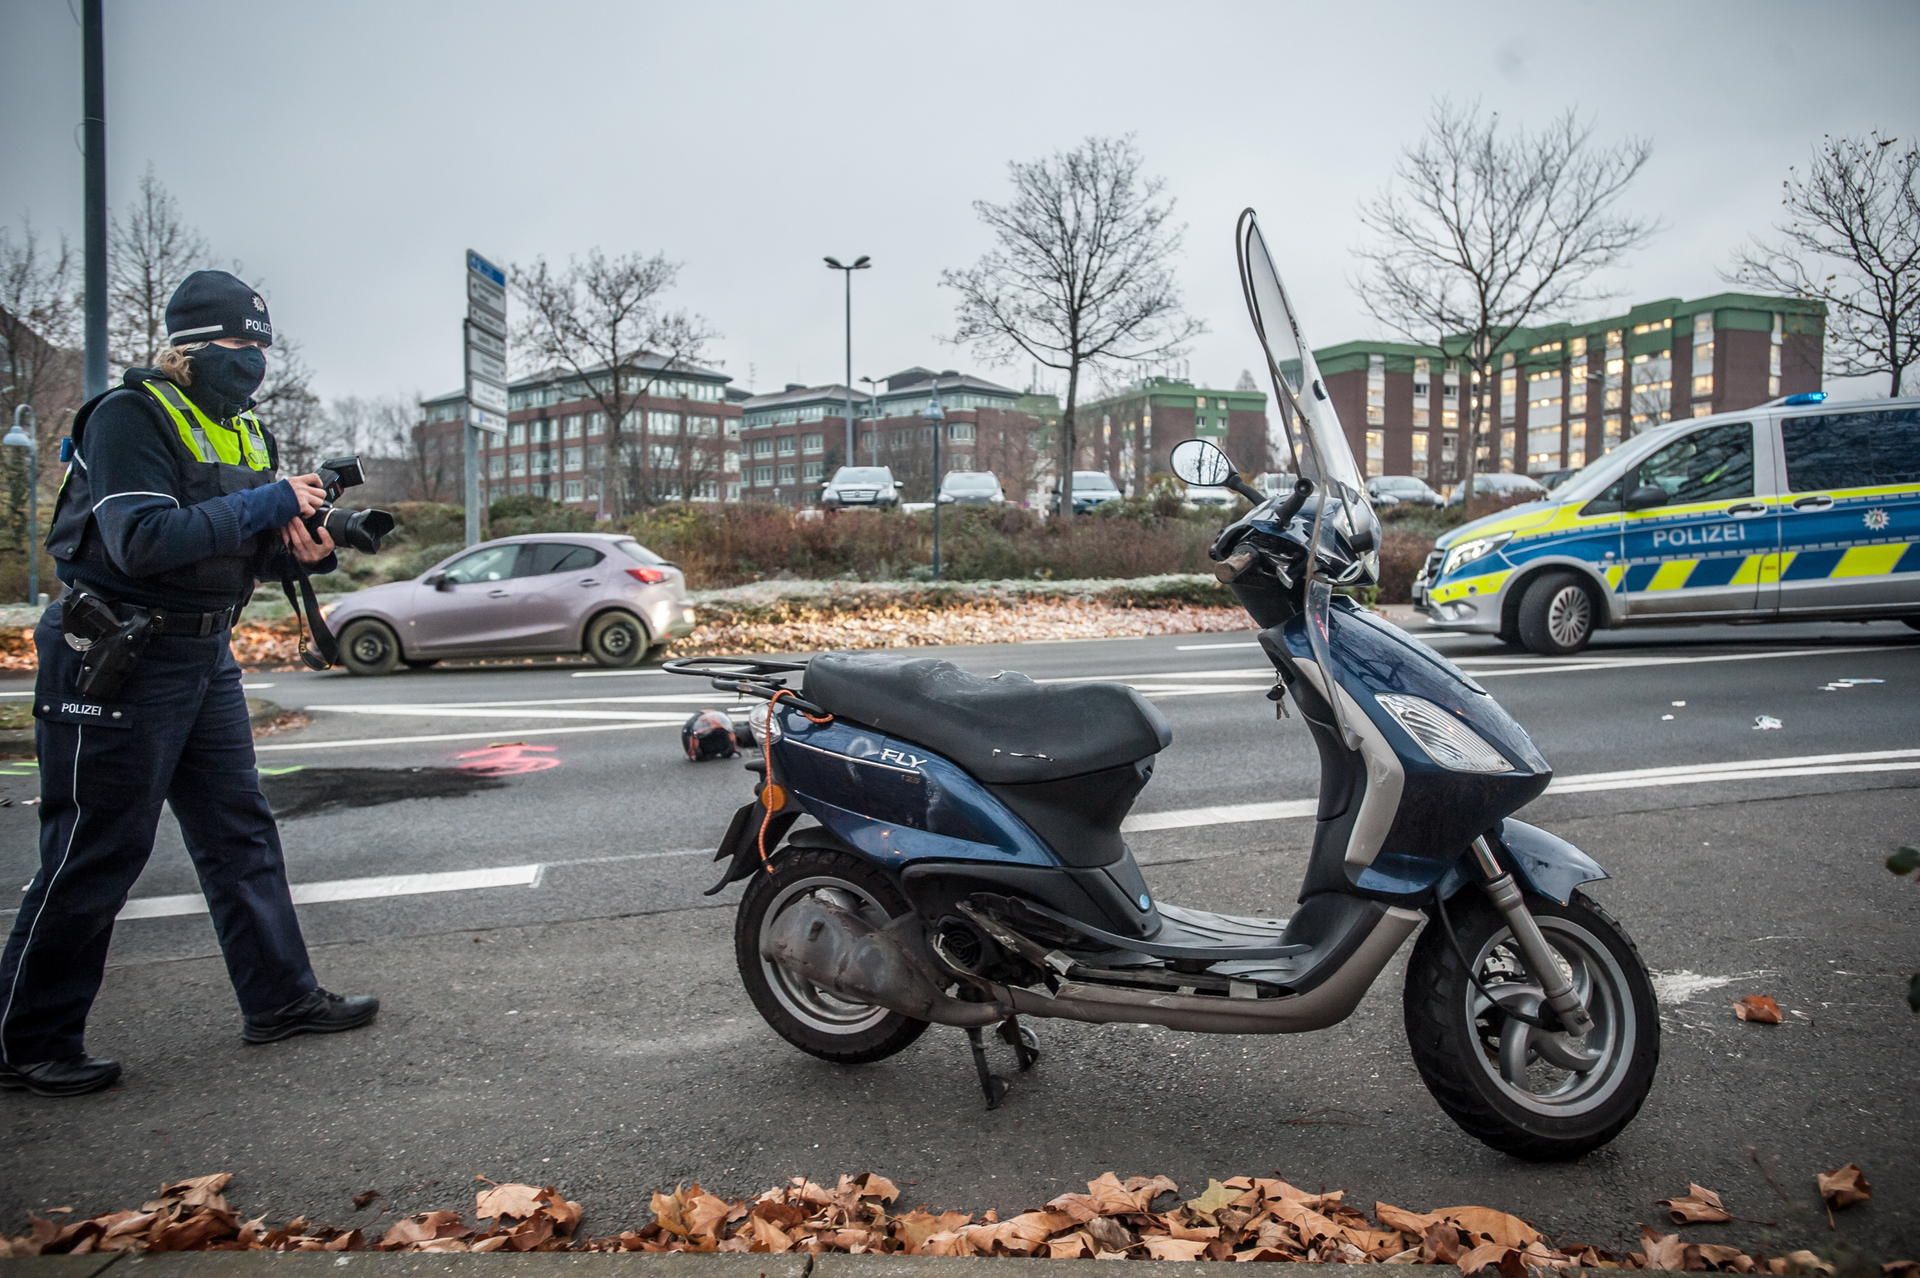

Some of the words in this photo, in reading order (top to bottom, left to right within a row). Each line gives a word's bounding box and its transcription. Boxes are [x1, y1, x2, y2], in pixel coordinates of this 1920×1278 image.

[1653, 523, 1745, 548] POLIZEI
[61, 702, 102, 716] POLIZEI
[880, 748, 928, 768] FLY
